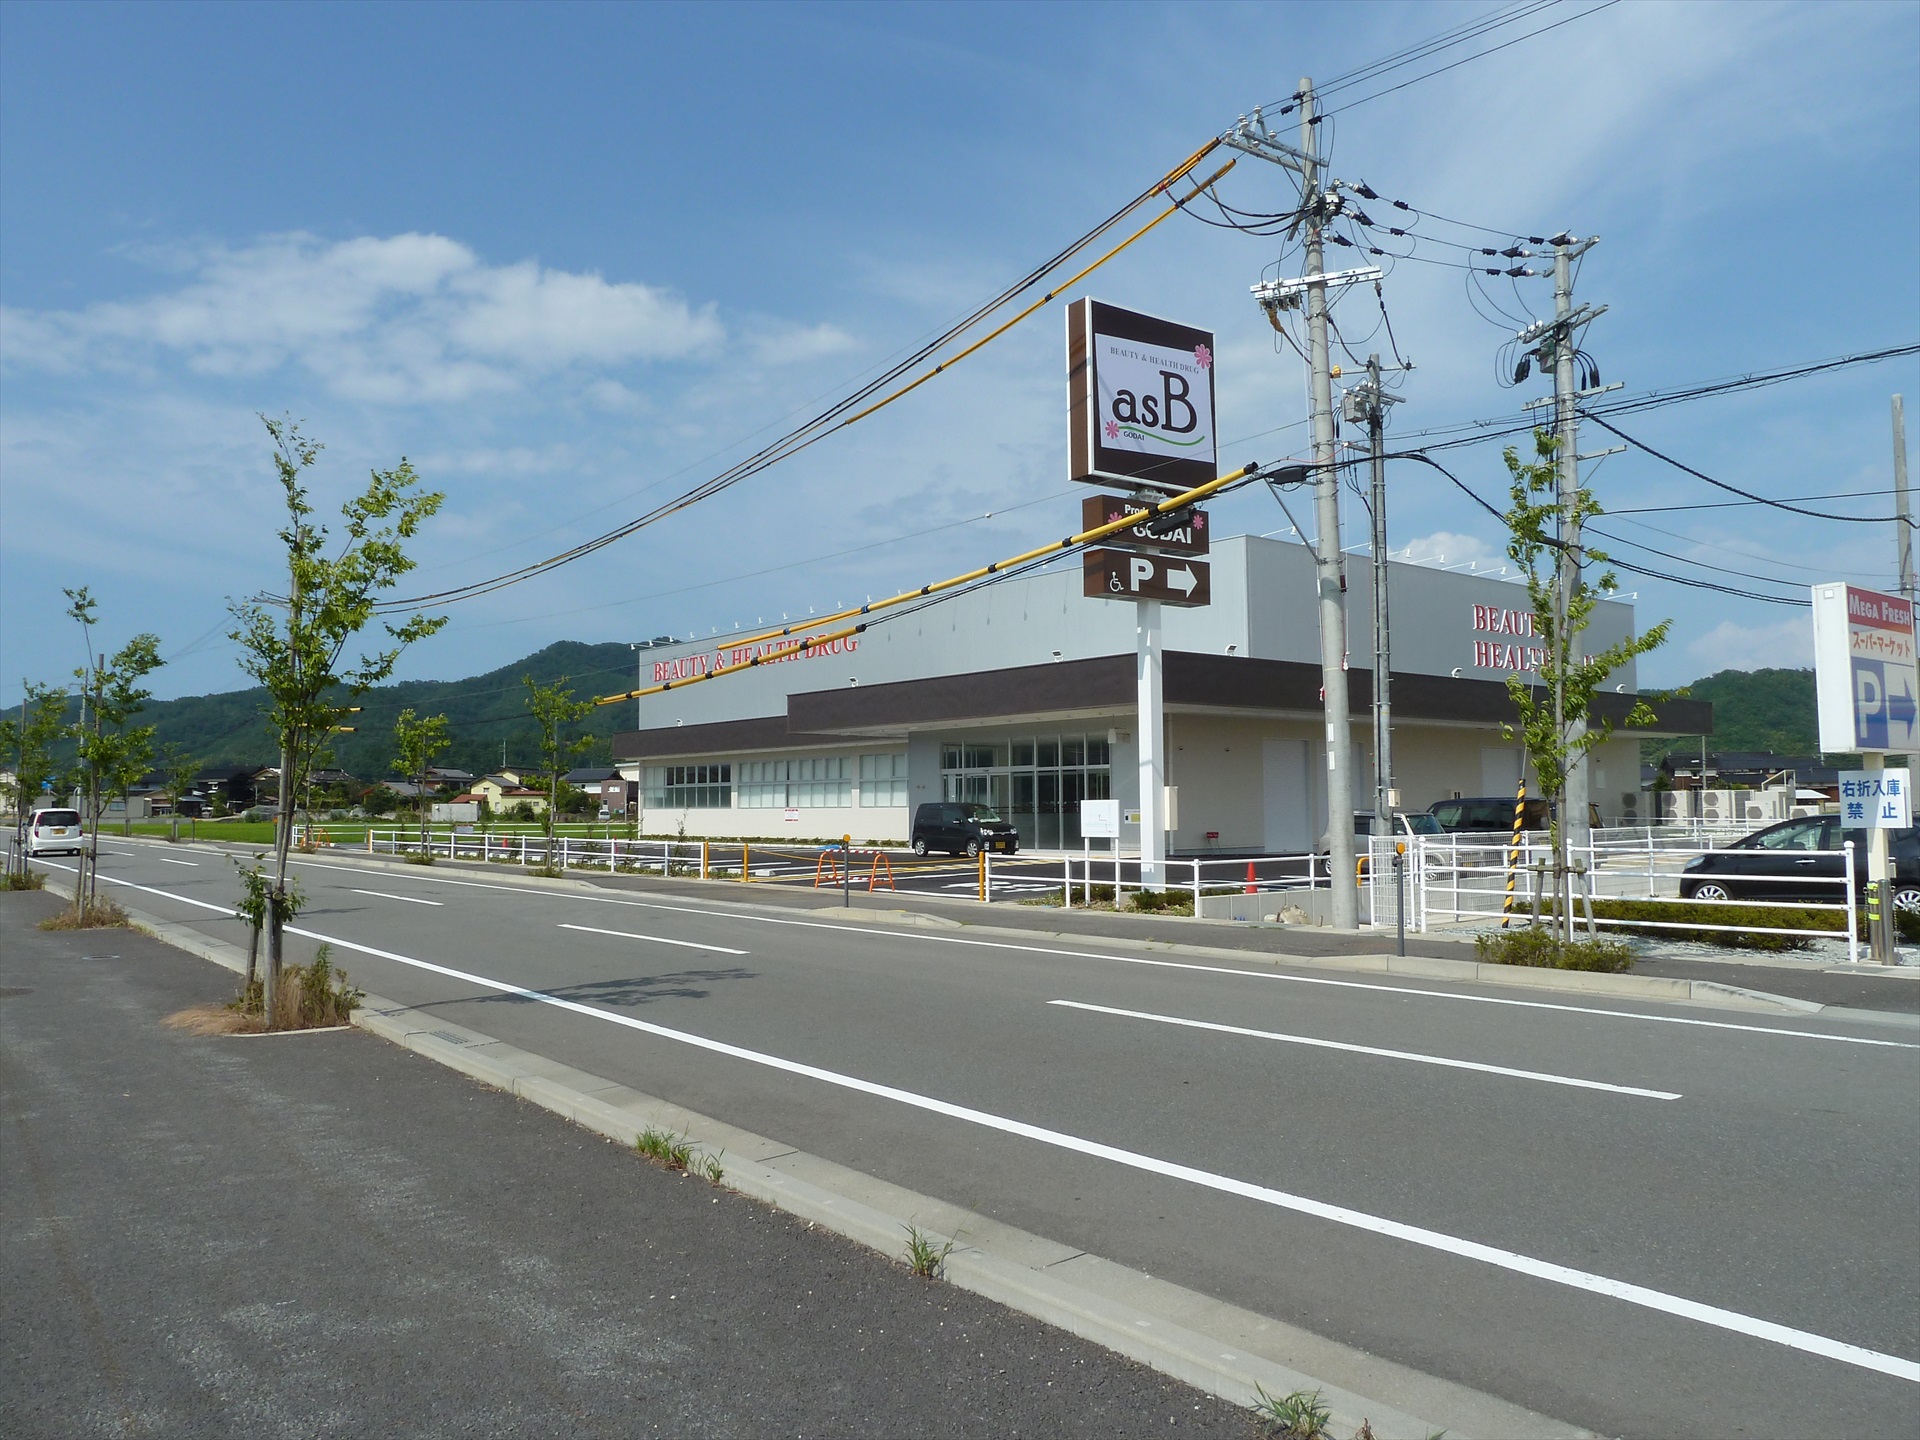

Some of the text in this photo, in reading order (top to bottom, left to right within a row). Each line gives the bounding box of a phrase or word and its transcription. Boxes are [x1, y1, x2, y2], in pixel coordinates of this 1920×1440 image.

[1110, 346, 1199, 374] BEAUTY & HEALTH DRUG
[1112, 370, 1197, 433] asB
[1123, 430, 1145, 441] GODAI
[1130, 557, 1154, 591] P
[1472, 603, 1546, 639] BEAUT
[1849, 594, 1911, 626] MEGA FRESH
[654, 633, 858, 682] BEAUTY & HEALTH DRUG
[1853, 631, 1911, 658] スーパーマーケット
[1856, 669, 1882, 738] P
[1842, 779, 1901, 797] 右折入庫
